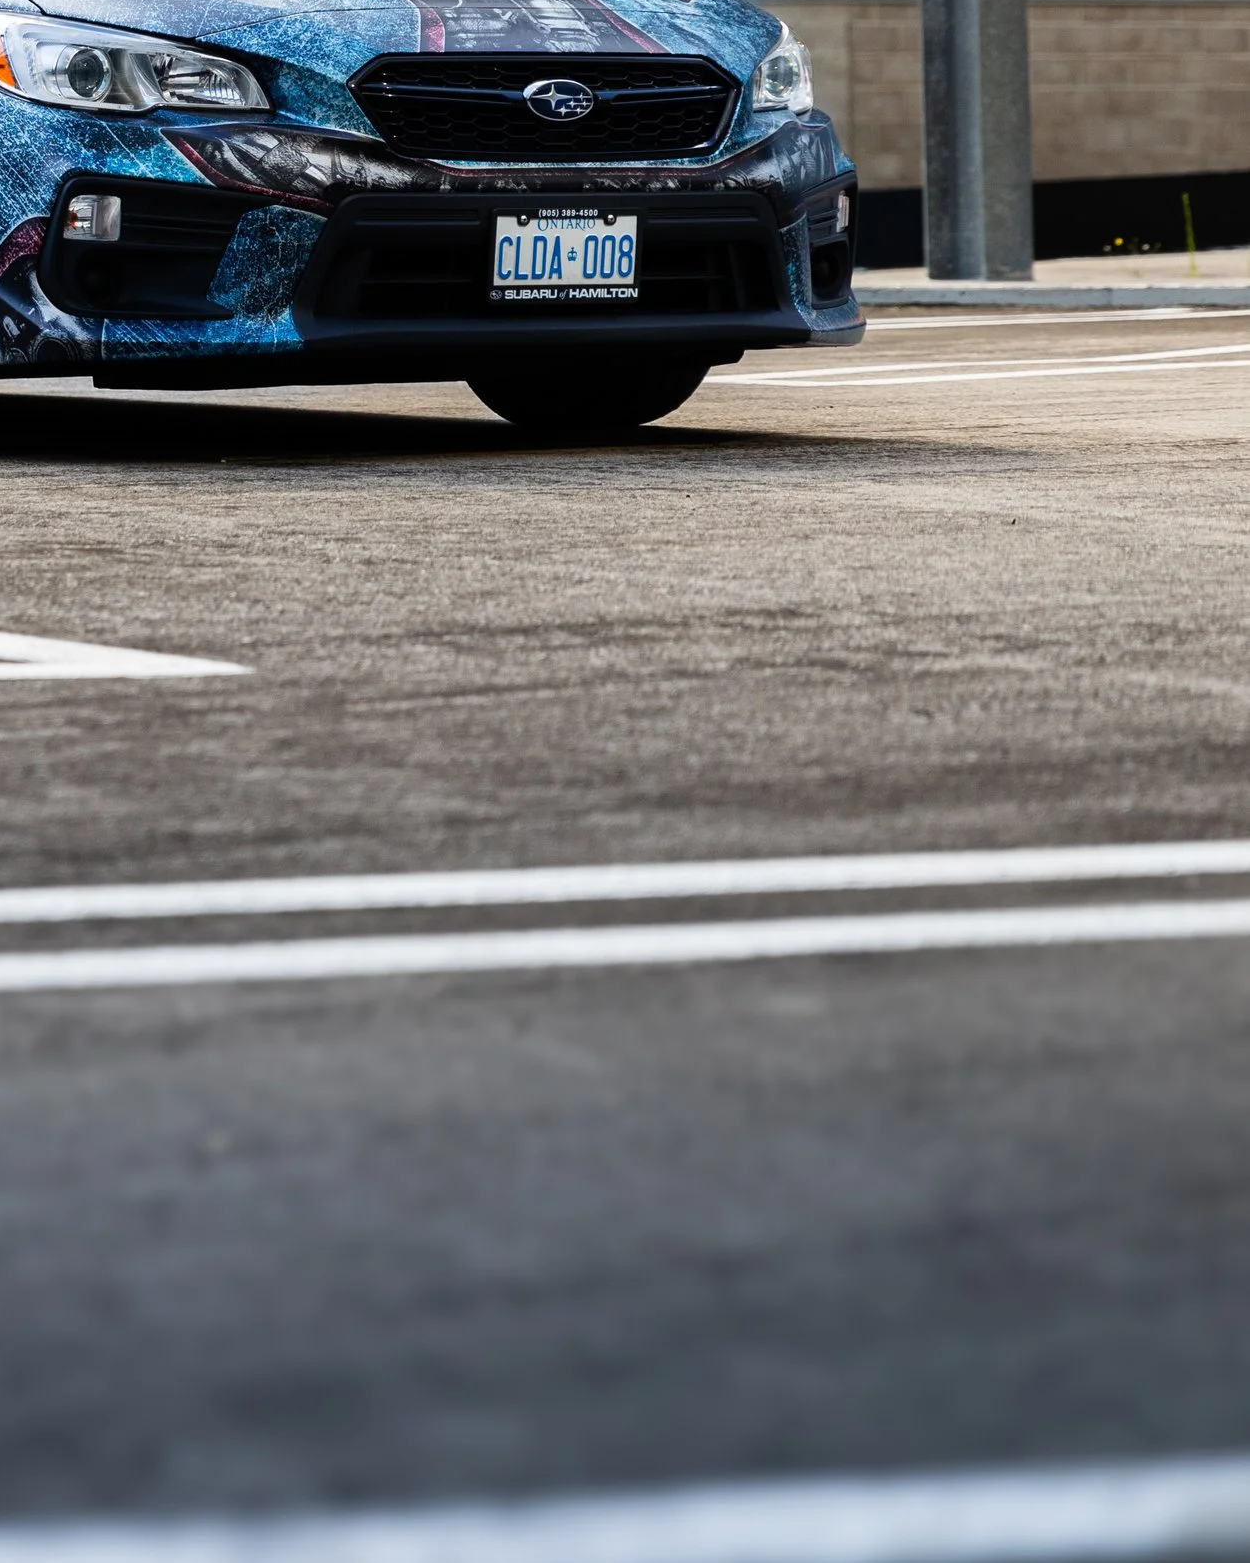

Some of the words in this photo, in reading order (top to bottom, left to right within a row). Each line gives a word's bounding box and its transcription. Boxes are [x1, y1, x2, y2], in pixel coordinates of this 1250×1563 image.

[538, 209, 559, 217] (905)
[561, 209, 599, 217] 389-4500
[537, 218, 596, 231] ONTARIO
[496, 235, 563, 280] CLDA
[583, 234, 634, 279] 008
[504, 289, 558, 299] SUBARU
[559, 289, 568, 300] of
[569, 288, 639, 298] HAMILTON
